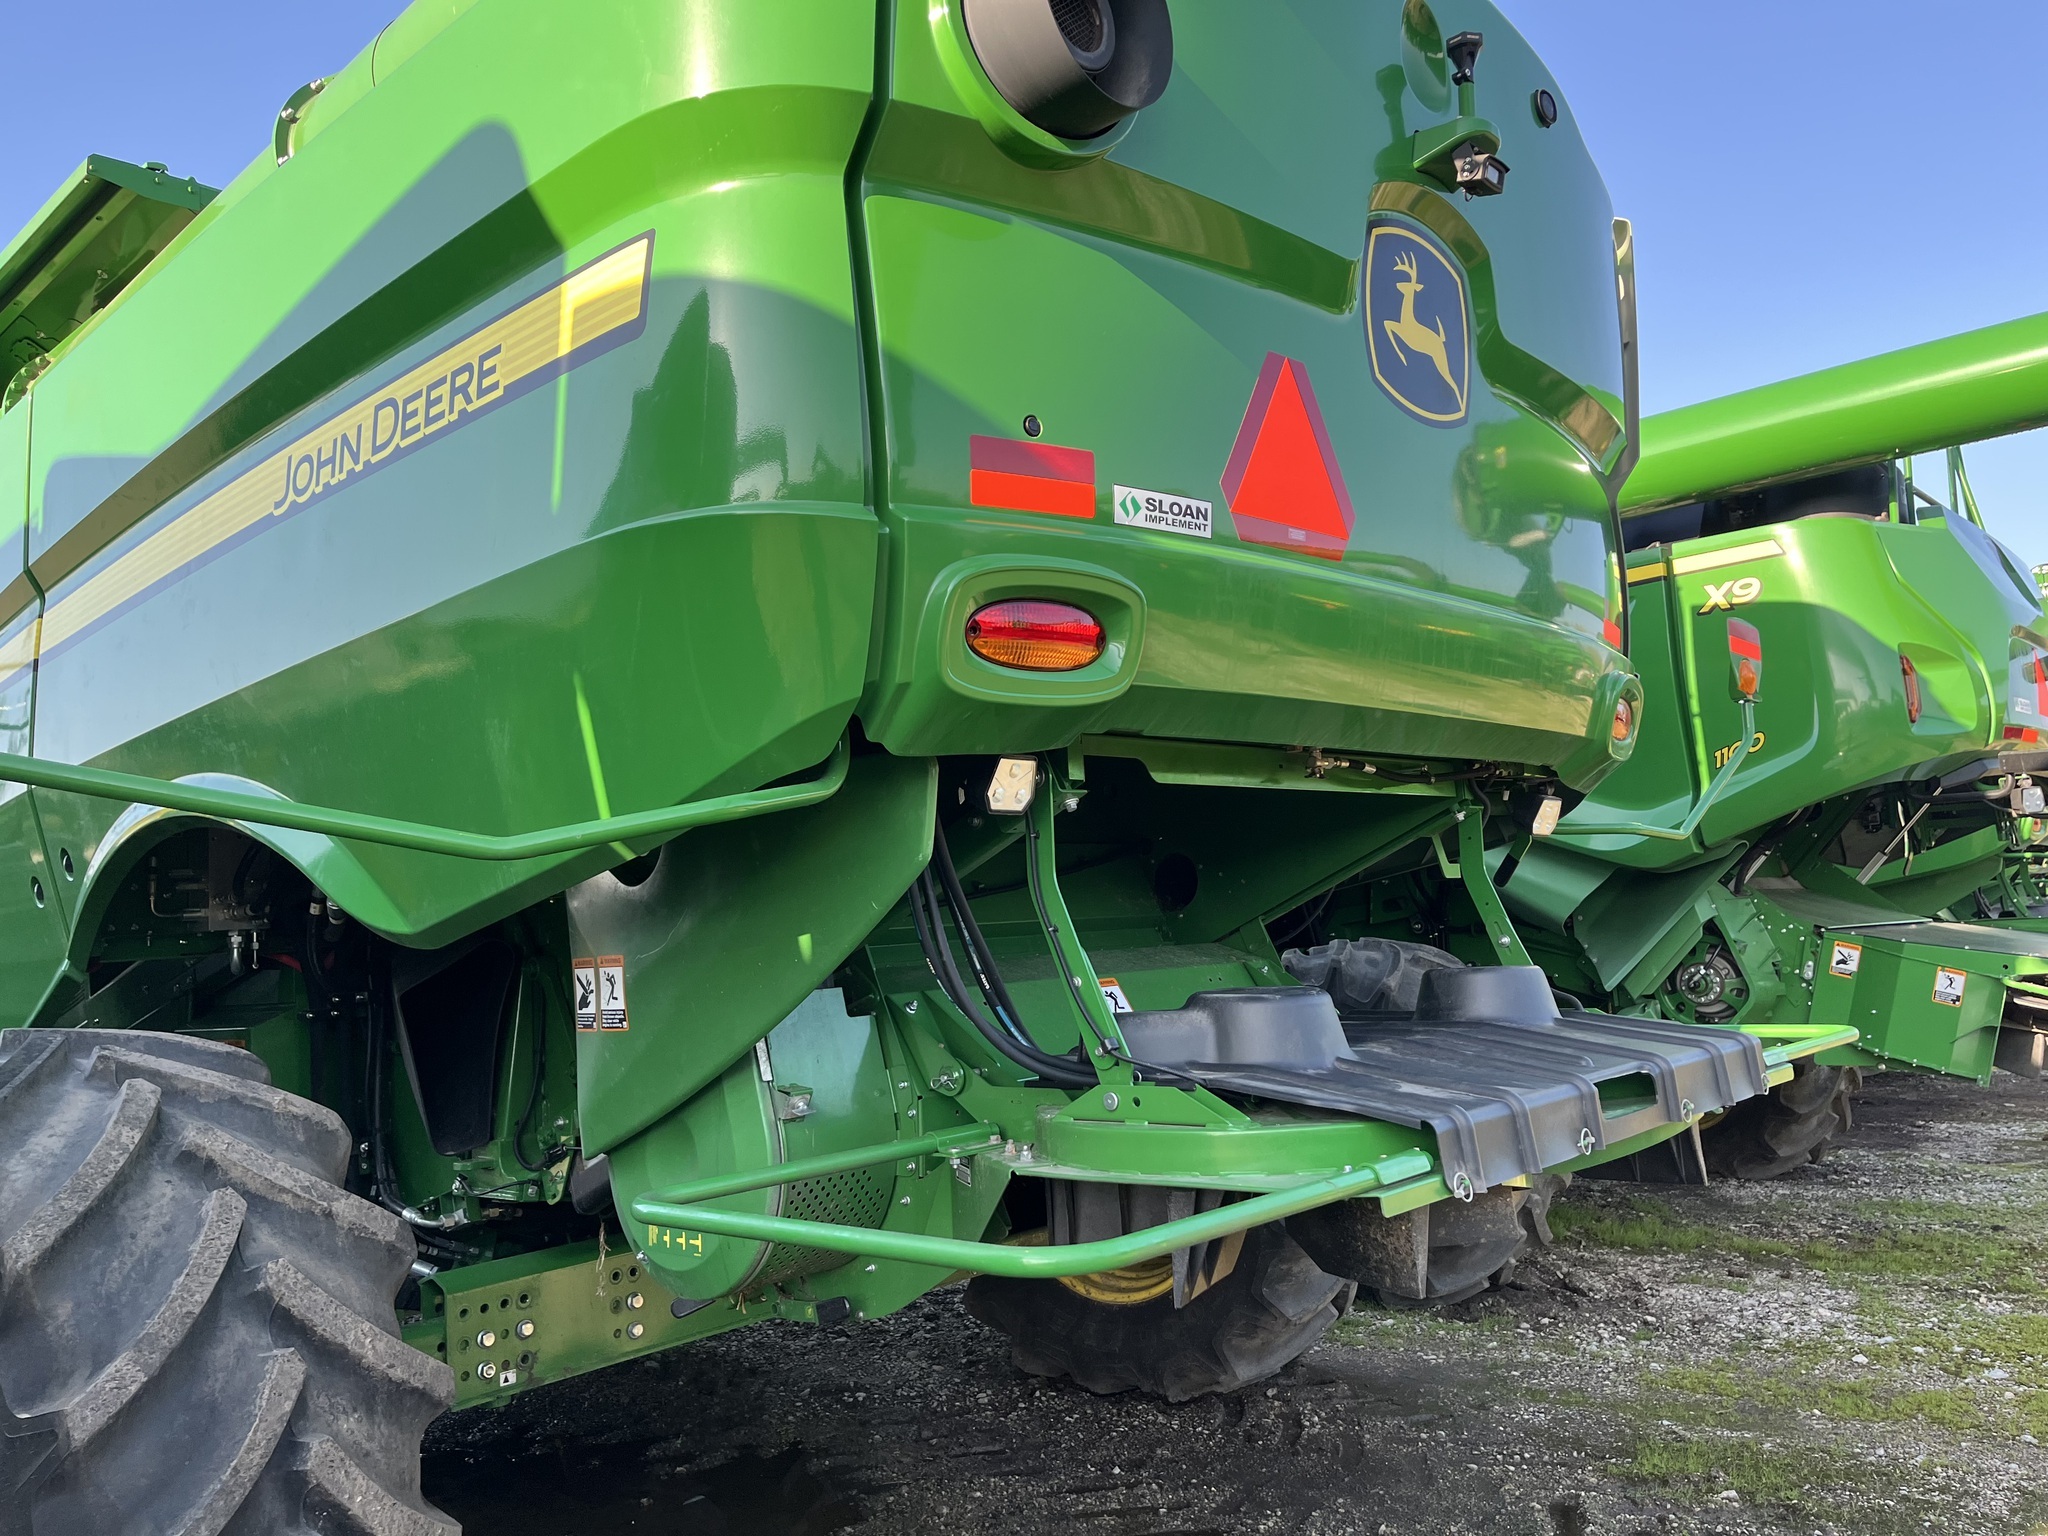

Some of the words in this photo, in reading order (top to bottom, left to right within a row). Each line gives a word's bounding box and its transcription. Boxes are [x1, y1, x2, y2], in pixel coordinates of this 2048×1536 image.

[273, 423, 362, 511] JOHN
[370, 343, 503, 460] DEERE
[1144, 497, 1208, 522] SLOAN
[1145, 513, 1208, 532] IMPLEMENT
[1697, 576, 1763, 616] X9
